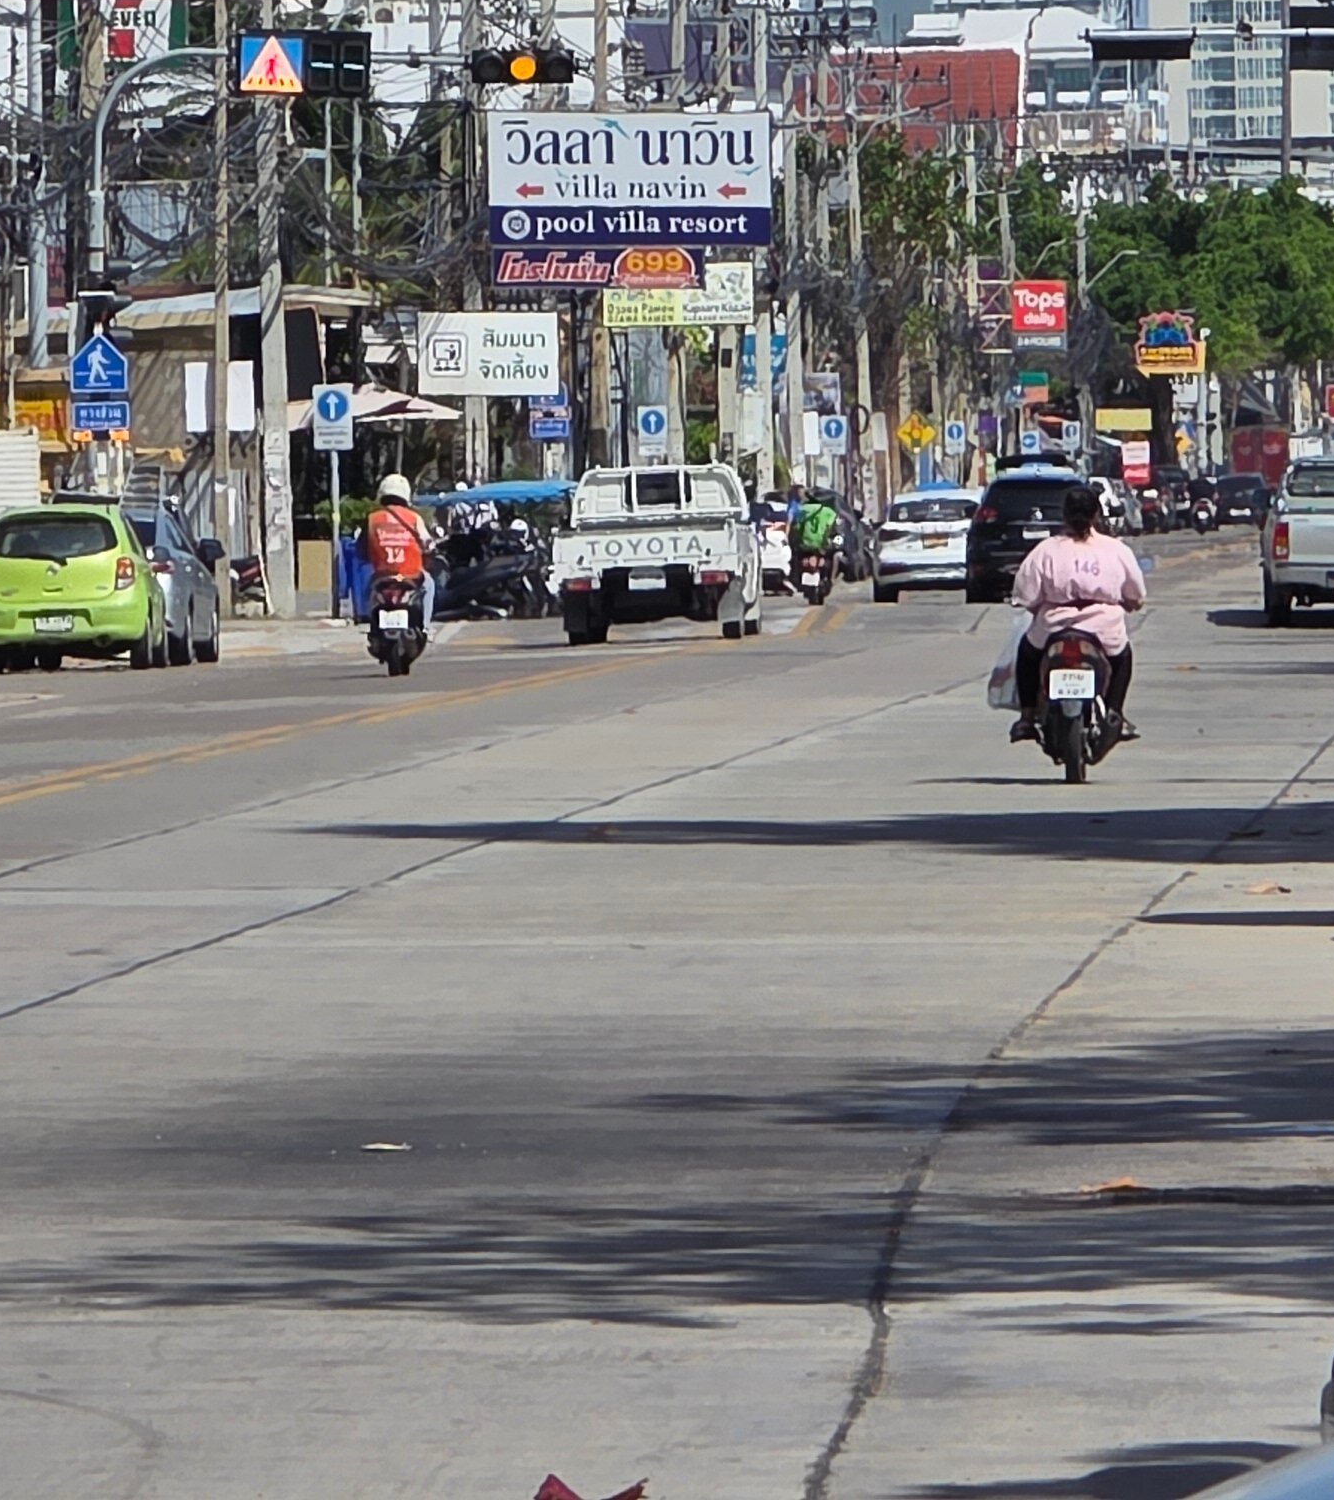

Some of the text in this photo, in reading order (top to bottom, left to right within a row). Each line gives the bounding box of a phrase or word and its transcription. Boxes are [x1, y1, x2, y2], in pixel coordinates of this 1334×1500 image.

[501, 119, 756, 166] วิลลา นาวิน
[555, 175, 707, 200] villa navin
[536, 211, 748, 241] pool villa resort
[626, 252, 683, 273] 699
[1013, 289, 1065, 311] Tops
[1024, 312, 1055, 327] daily
[482, 328, 546, 348] สัมมนา
[478, 353, 549, 379] จัดเลี้ยง
[586, 535, 703, 557] TOYOTA
[1073, 560, 1101, 576] 146
